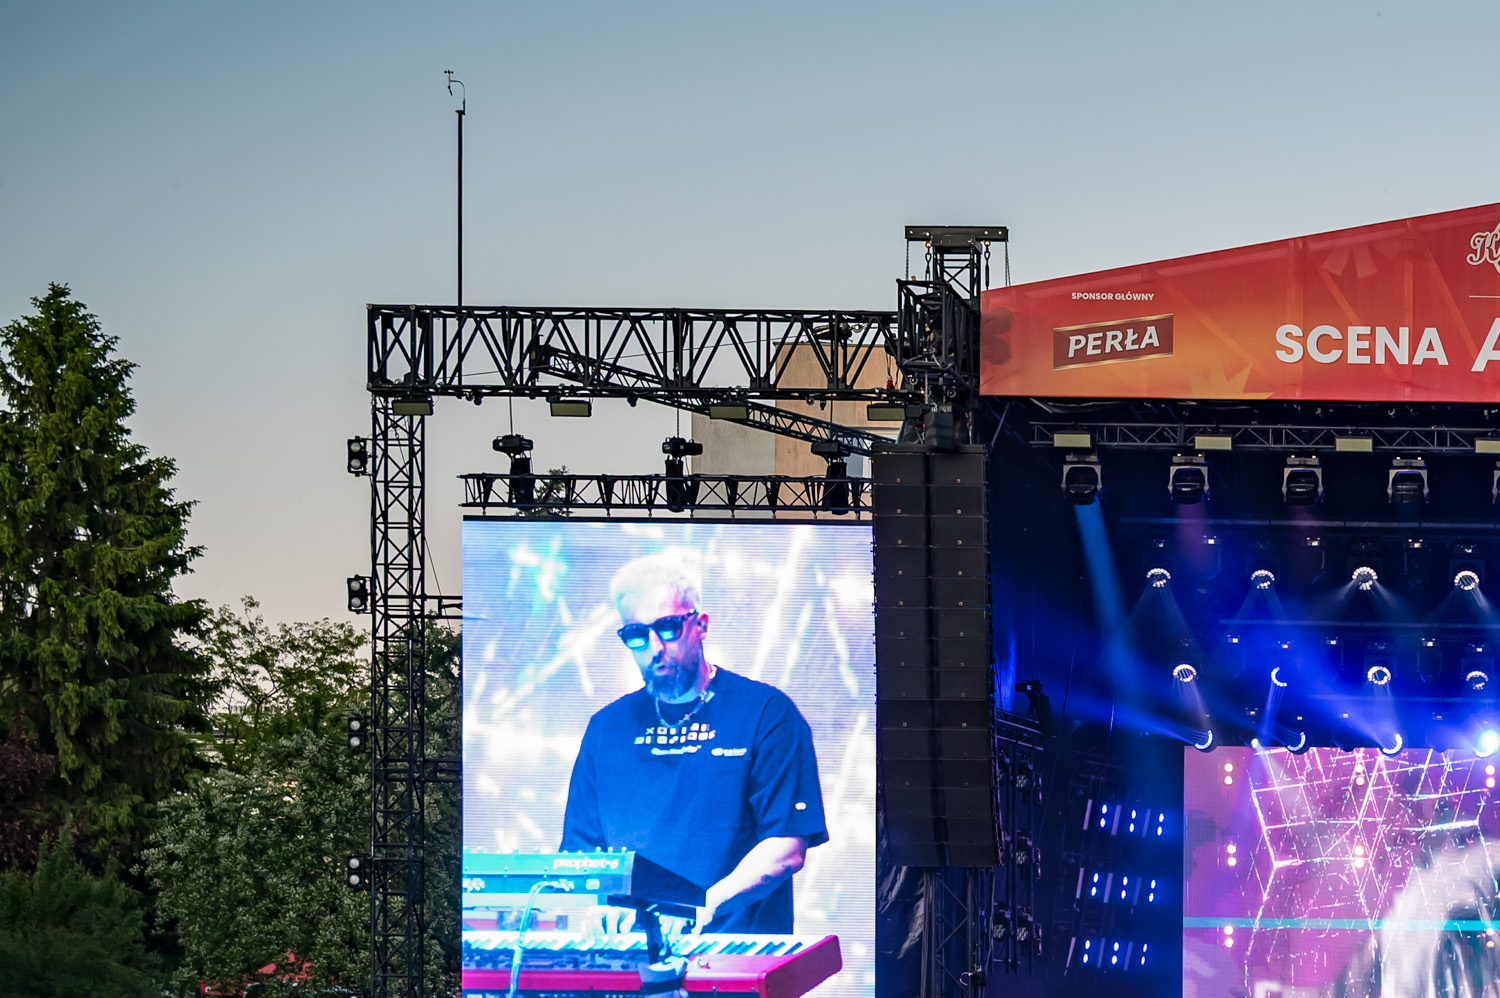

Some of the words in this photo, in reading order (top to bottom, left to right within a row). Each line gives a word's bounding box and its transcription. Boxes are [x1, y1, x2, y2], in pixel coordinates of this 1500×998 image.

[1071, 292, 1113, 300] SPONSOR
[1114, 291, 1154, 301] GŁÓWNY
[1068, 326, 1160, 358] PERŁA
[1275, 324, 1449, 366] SCENA
